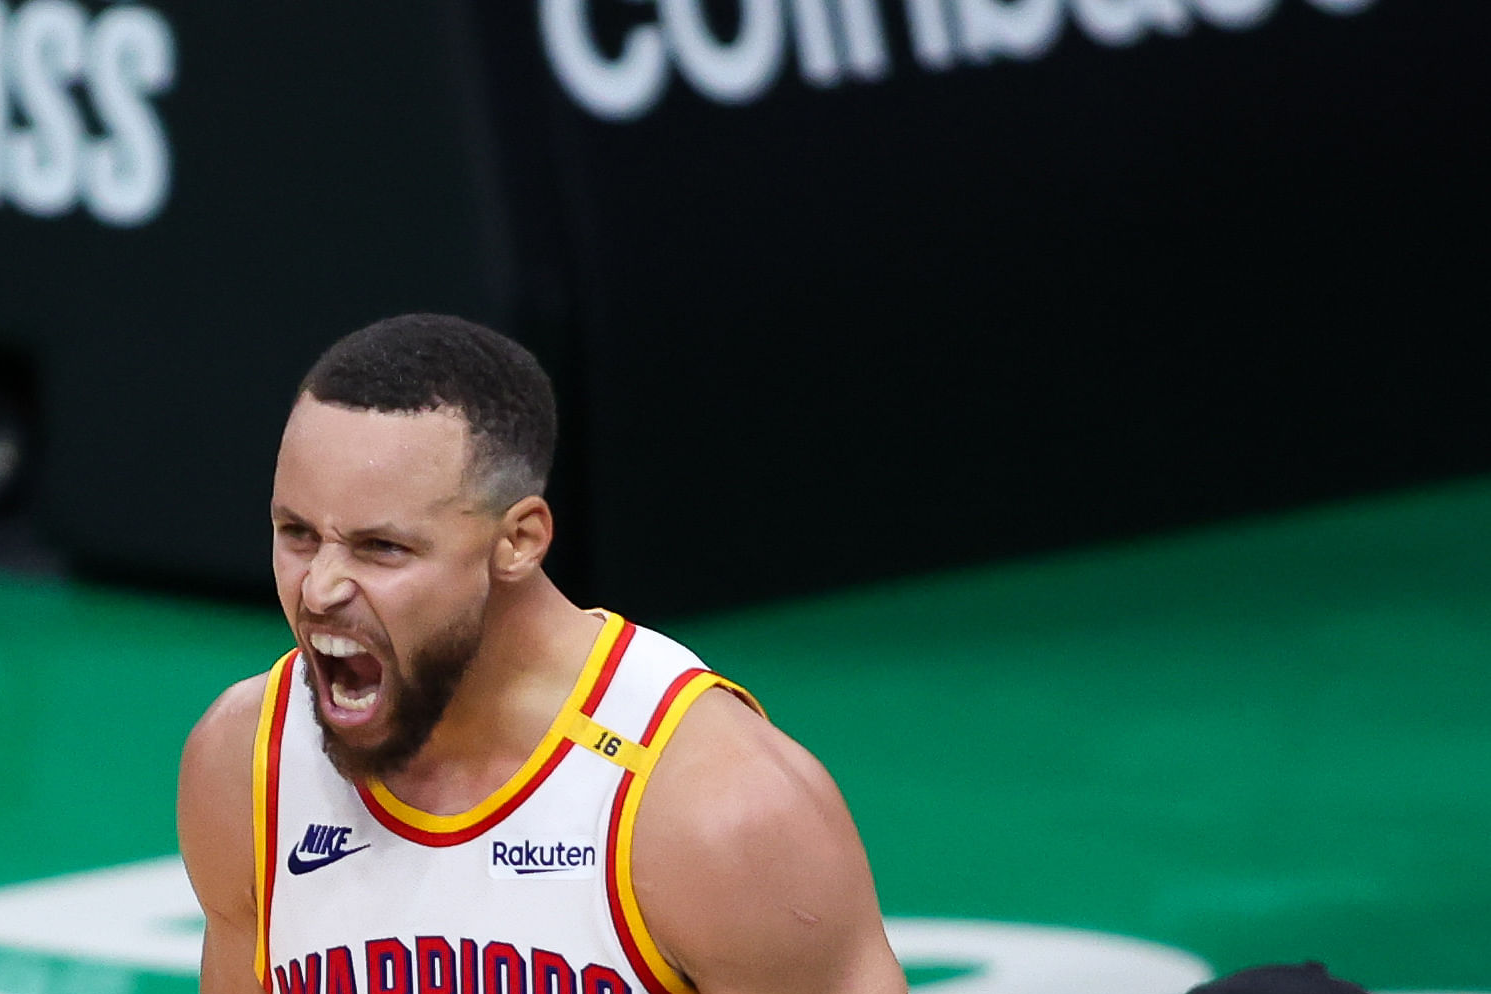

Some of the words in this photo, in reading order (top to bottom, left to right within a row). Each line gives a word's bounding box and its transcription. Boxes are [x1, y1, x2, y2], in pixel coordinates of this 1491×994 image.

[593, 731, 623, 757] 16
[299, 824, 353, 856] NIKE
[492, 840, 596, 867] Rakuten
